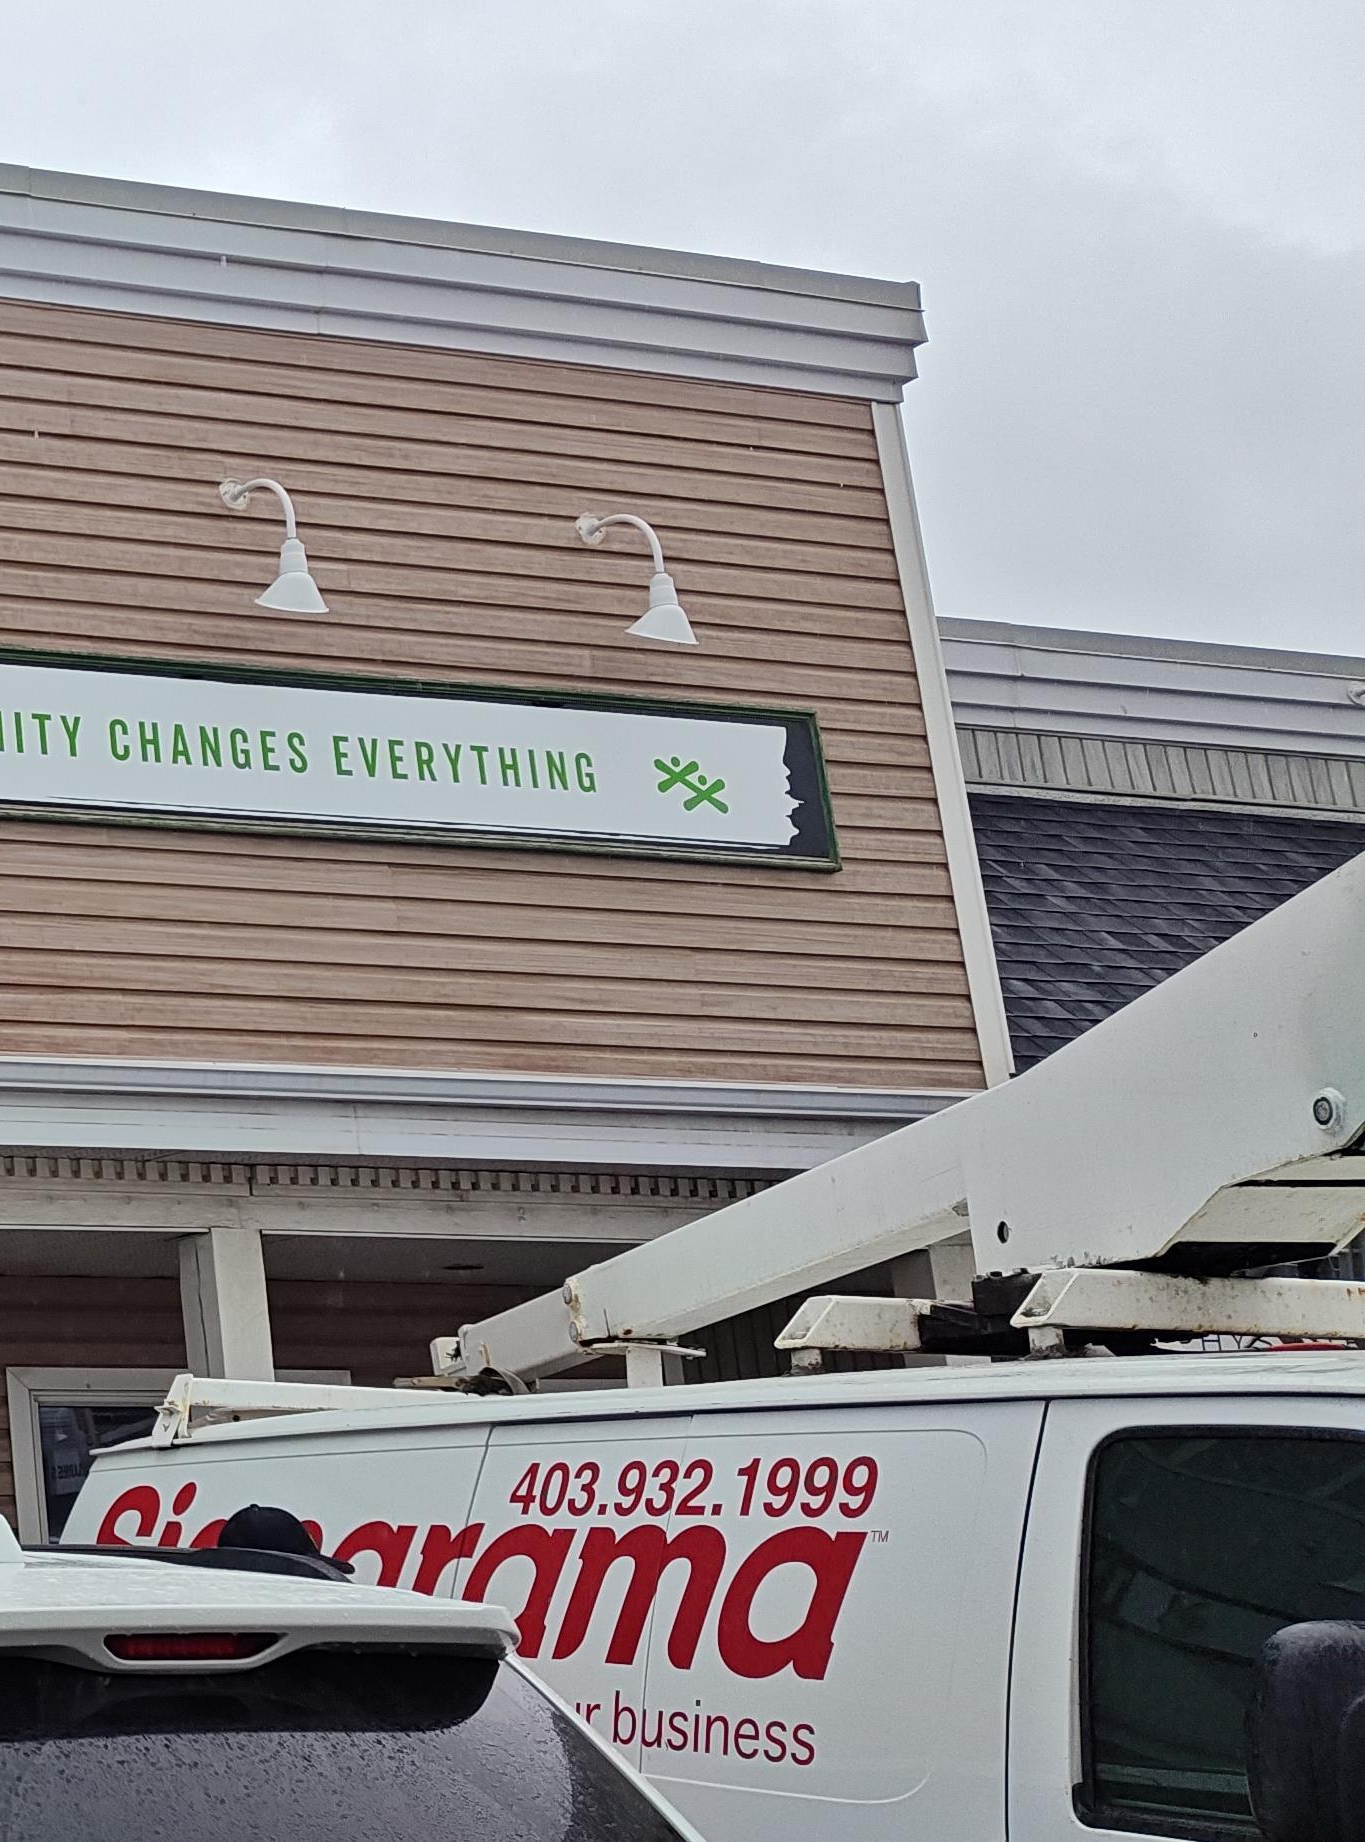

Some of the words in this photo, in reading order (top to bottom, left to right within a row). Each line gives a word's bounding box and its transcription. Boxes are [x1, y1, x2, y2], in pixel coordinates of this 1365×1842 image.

[109, 719, 309, 775] CHANGES
[334, 736, 599, 794] EVERYTHING
[508, 1455, 880, 1519] 403.932.1999
[96, 1481, 869, 1681] arama
[612, 1689, 816, 1766] business
